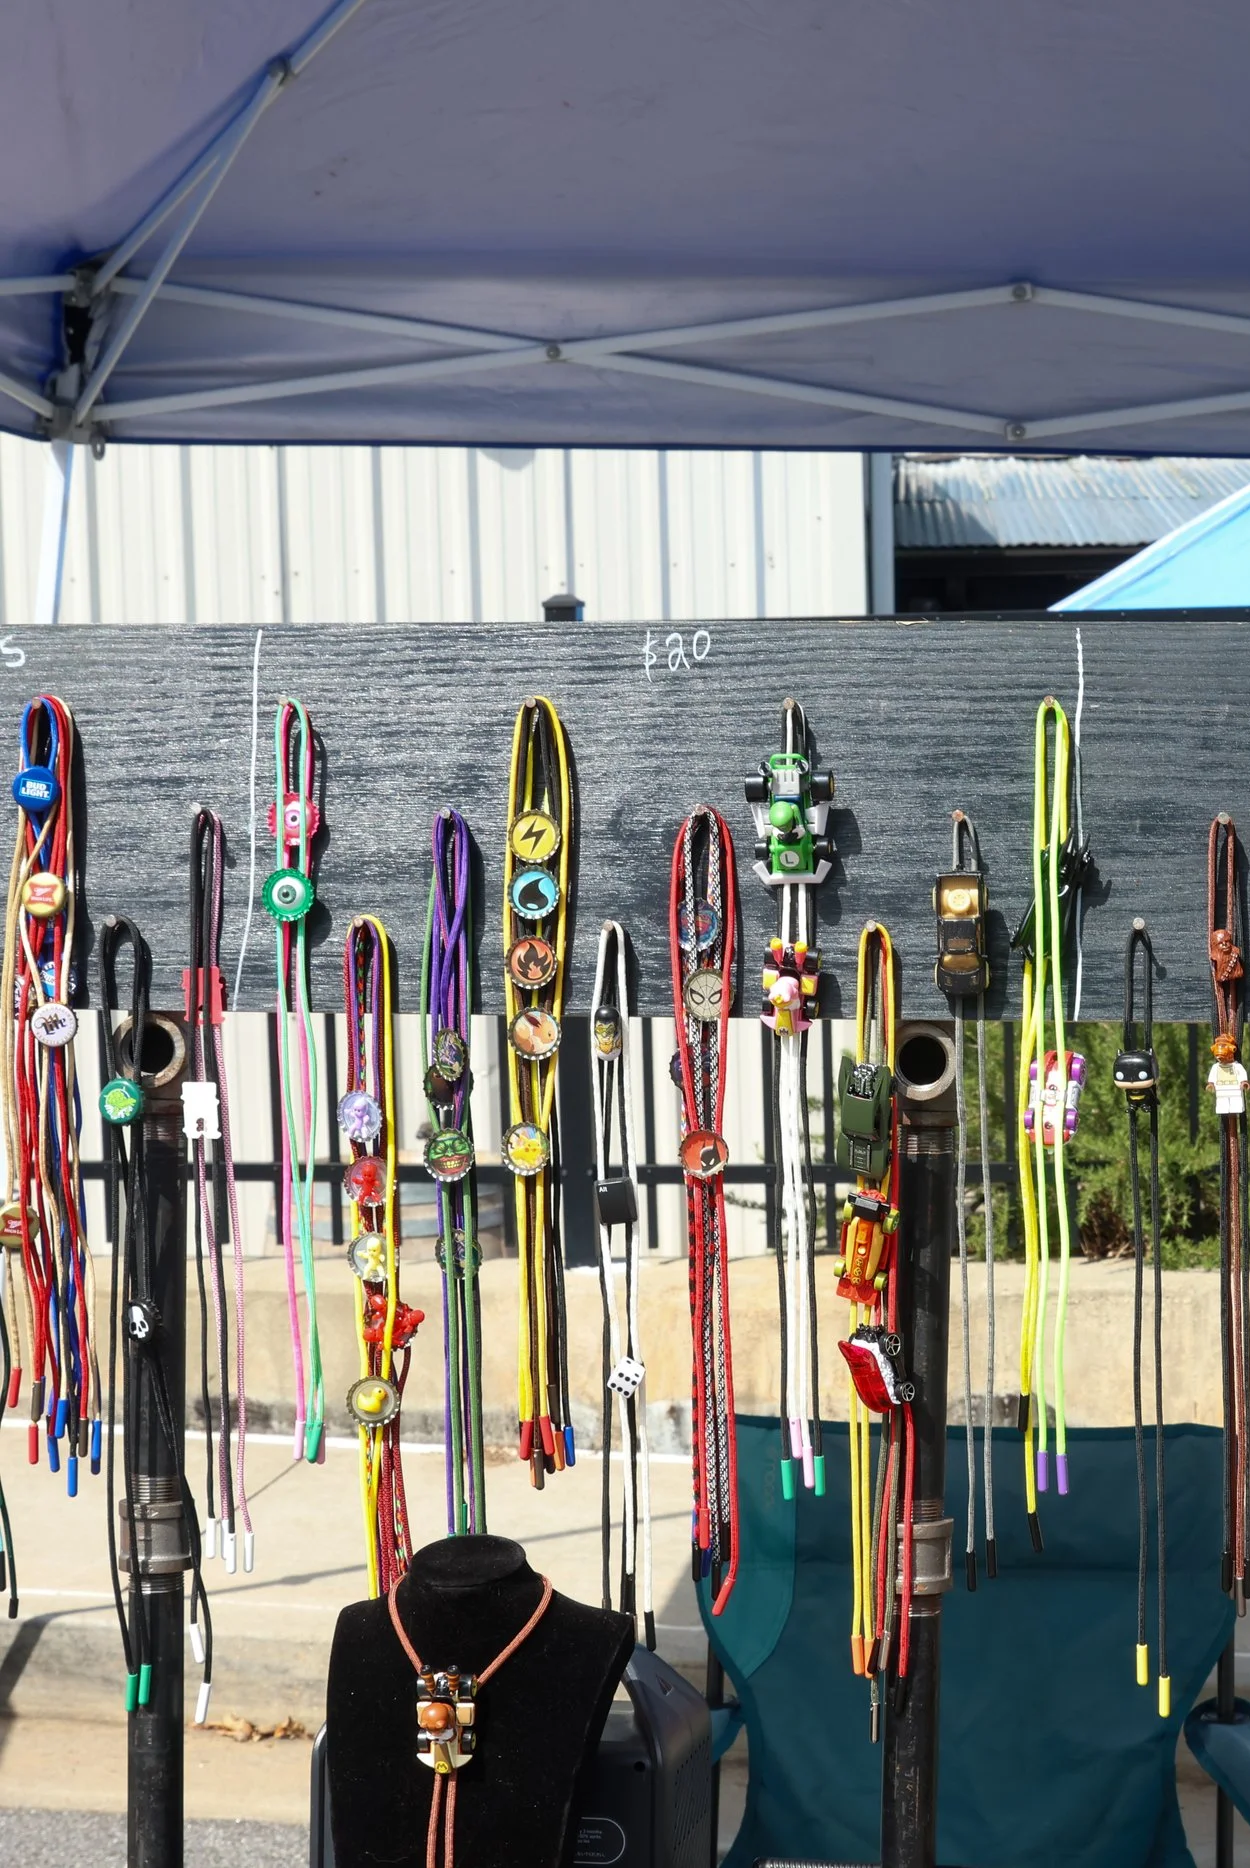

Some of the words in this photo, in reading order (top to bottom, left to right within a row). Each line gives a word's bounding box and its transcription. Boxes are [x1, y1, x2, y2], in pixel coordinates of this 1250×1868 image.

[642, 629, 711, 682] $20
[26, 780, 47, 791] BUD
[21, 786, 50, 798] LIGHT
[784, 853, 794, 864] L
[436, 1761, 448, 1770] M
